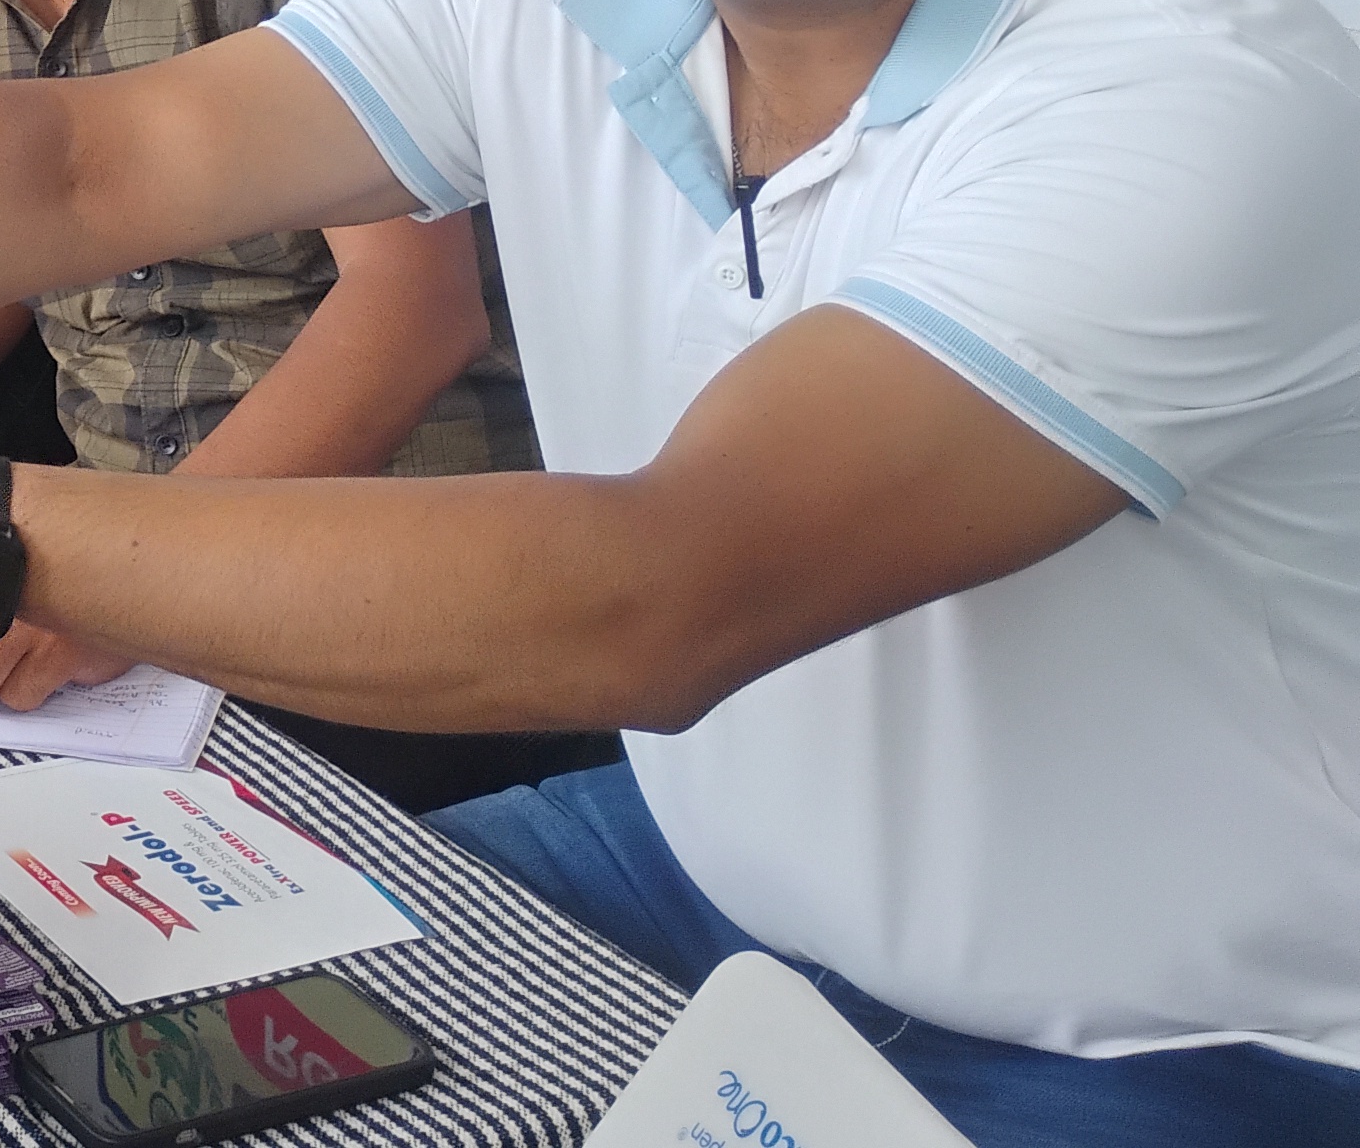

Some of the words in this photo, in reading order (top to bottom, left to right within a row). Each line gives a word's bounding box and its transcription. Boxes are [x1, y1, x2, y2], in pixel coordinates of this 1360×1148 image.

[163, 789, 203, 816] SPEED
[195, 815, 226, 832] and
[100, 811, 245, 913] Zerodol-P
[219, 831, 266, 864] POWER
